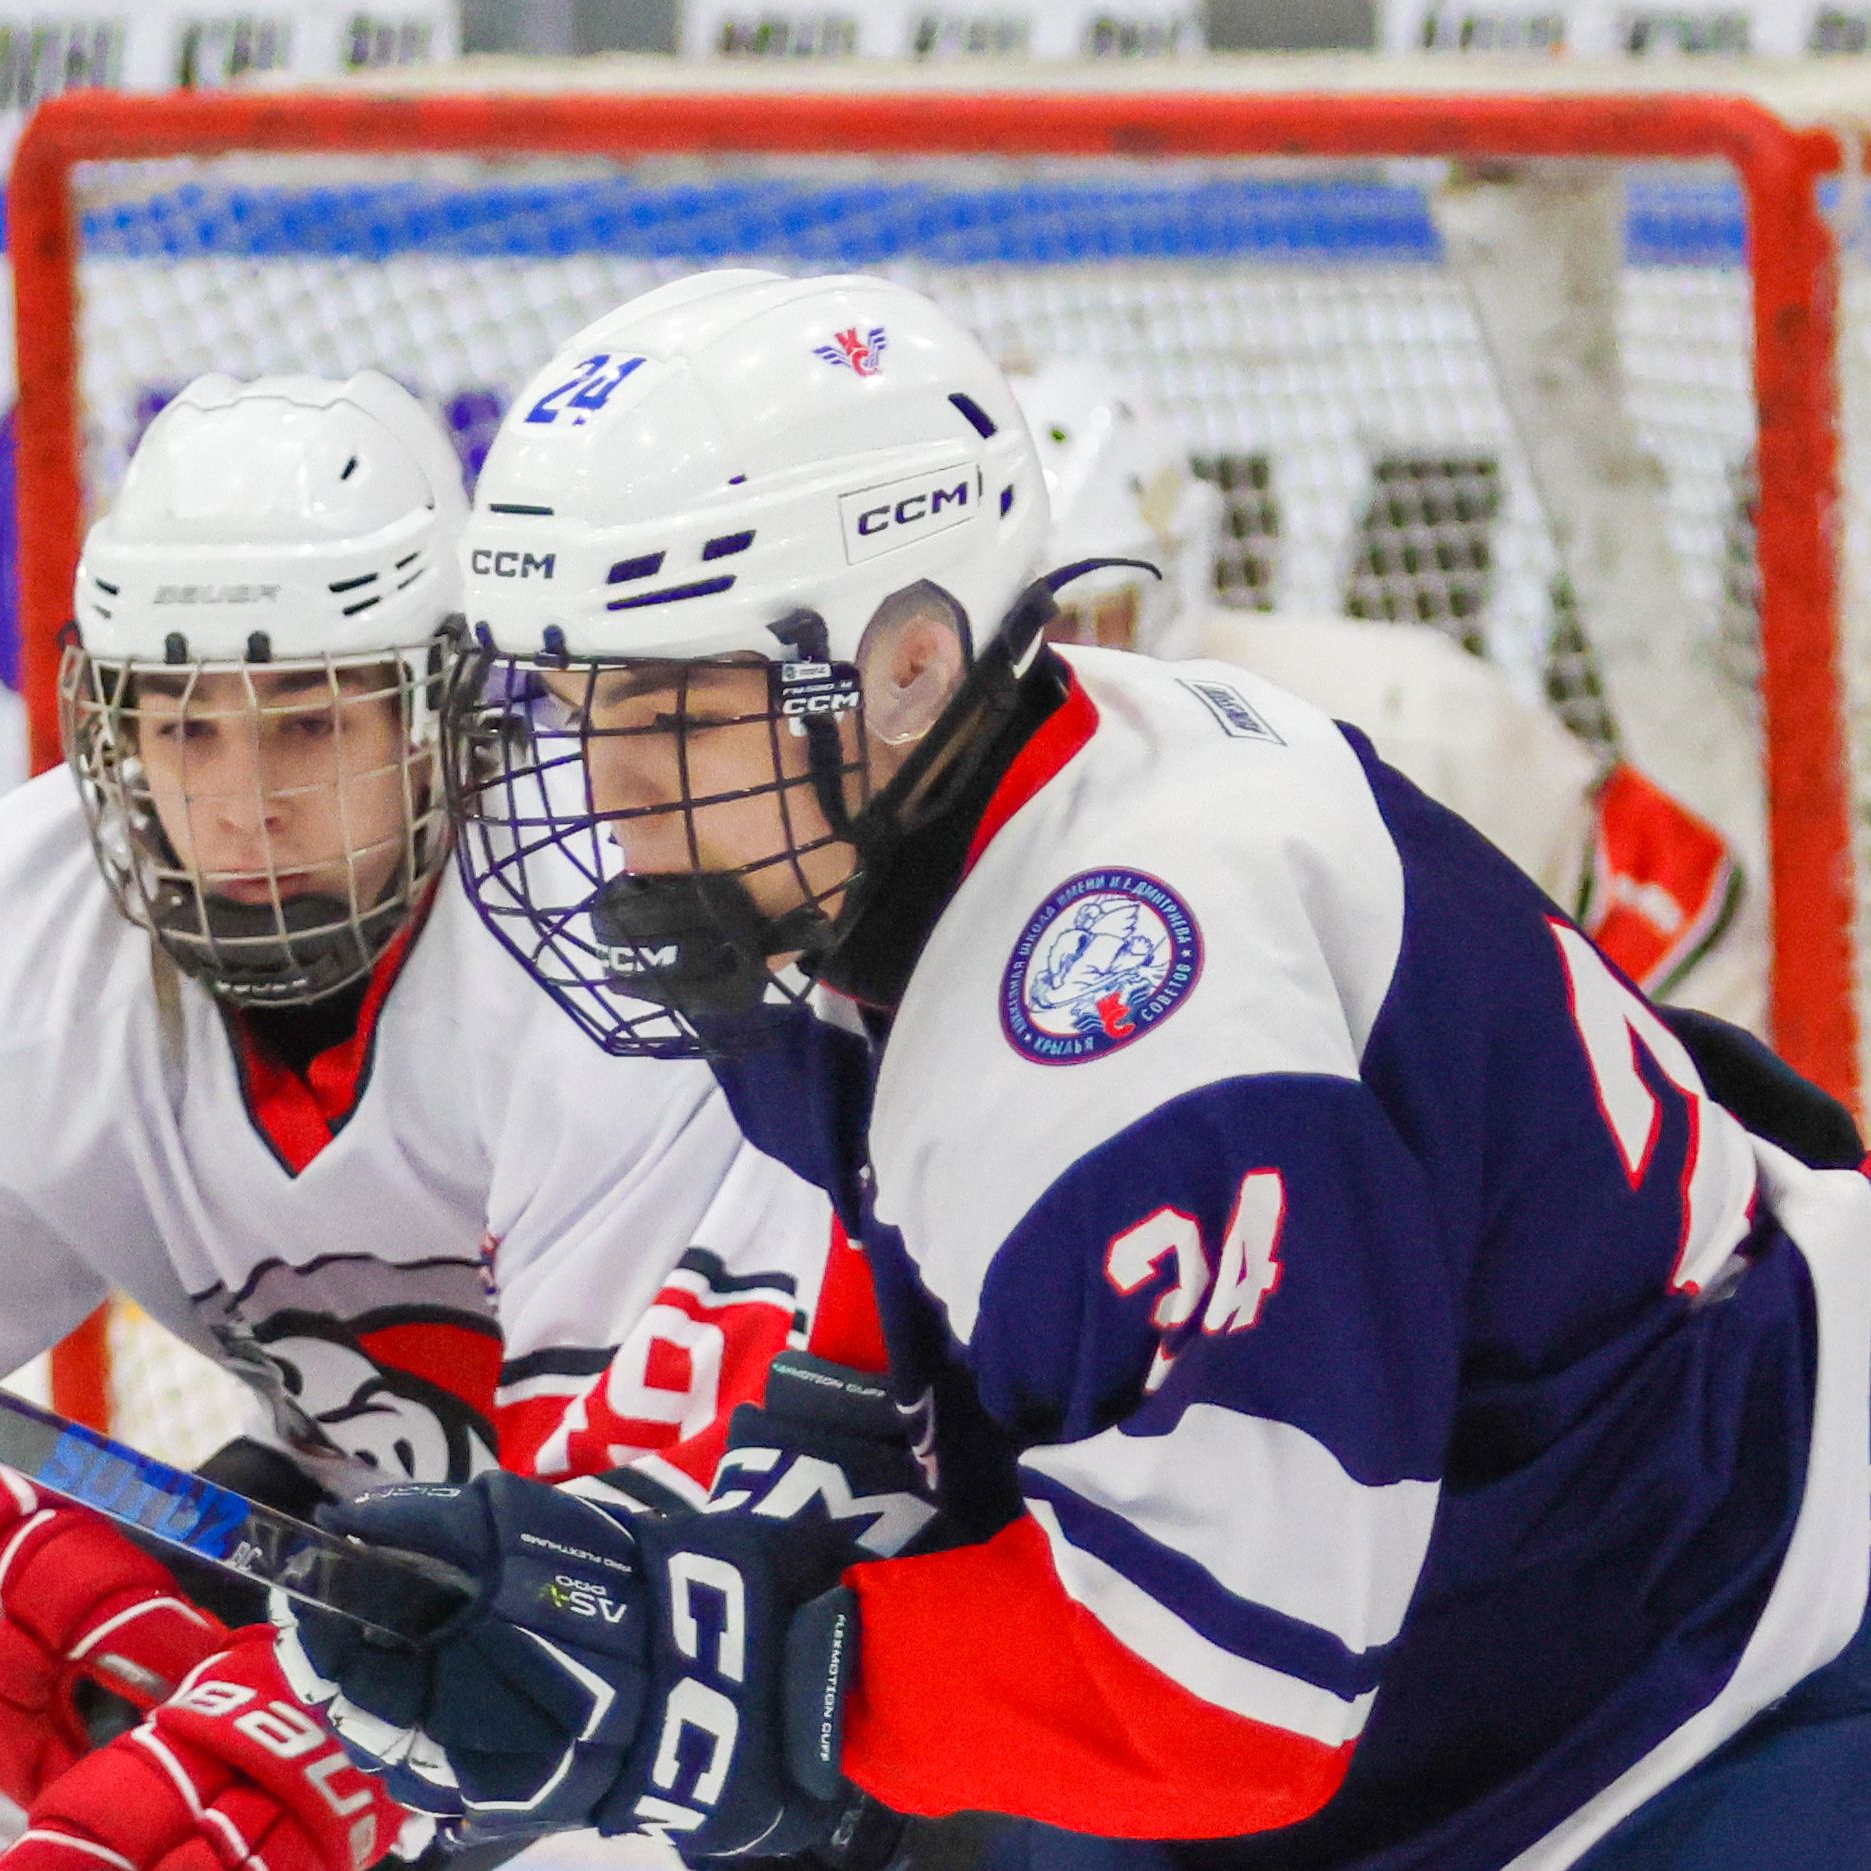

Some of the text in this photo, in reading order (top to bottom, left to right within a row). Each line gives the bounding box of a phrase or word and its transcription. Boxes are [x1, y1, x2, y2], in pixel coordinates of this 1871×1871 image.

[857, 480, 969, 537] CCM
[471, 548, 556, 580] CCM
[781, 690, 860, 715] CCM
